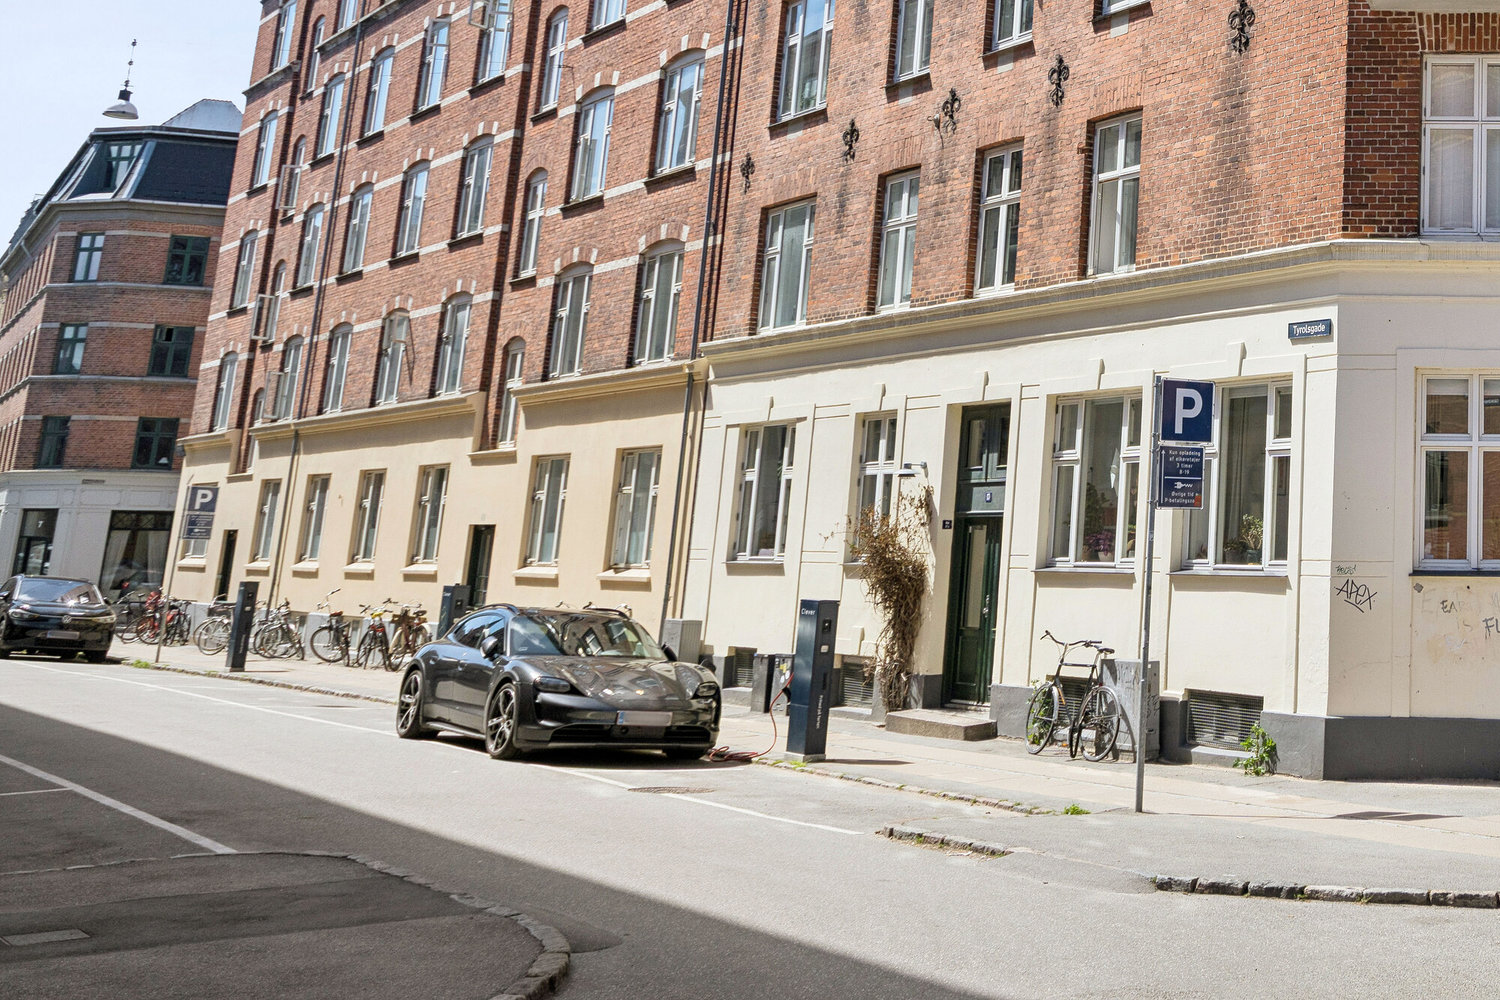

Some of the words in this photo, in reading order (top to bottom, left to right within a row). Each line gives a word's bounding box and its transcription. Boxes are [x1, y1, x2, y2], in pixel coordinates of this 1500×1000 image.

[1292, 323, 1325, 336] Tyrolsgade
[1174, 387, 1203, 434] P
[194, 489, 213, 510] P
